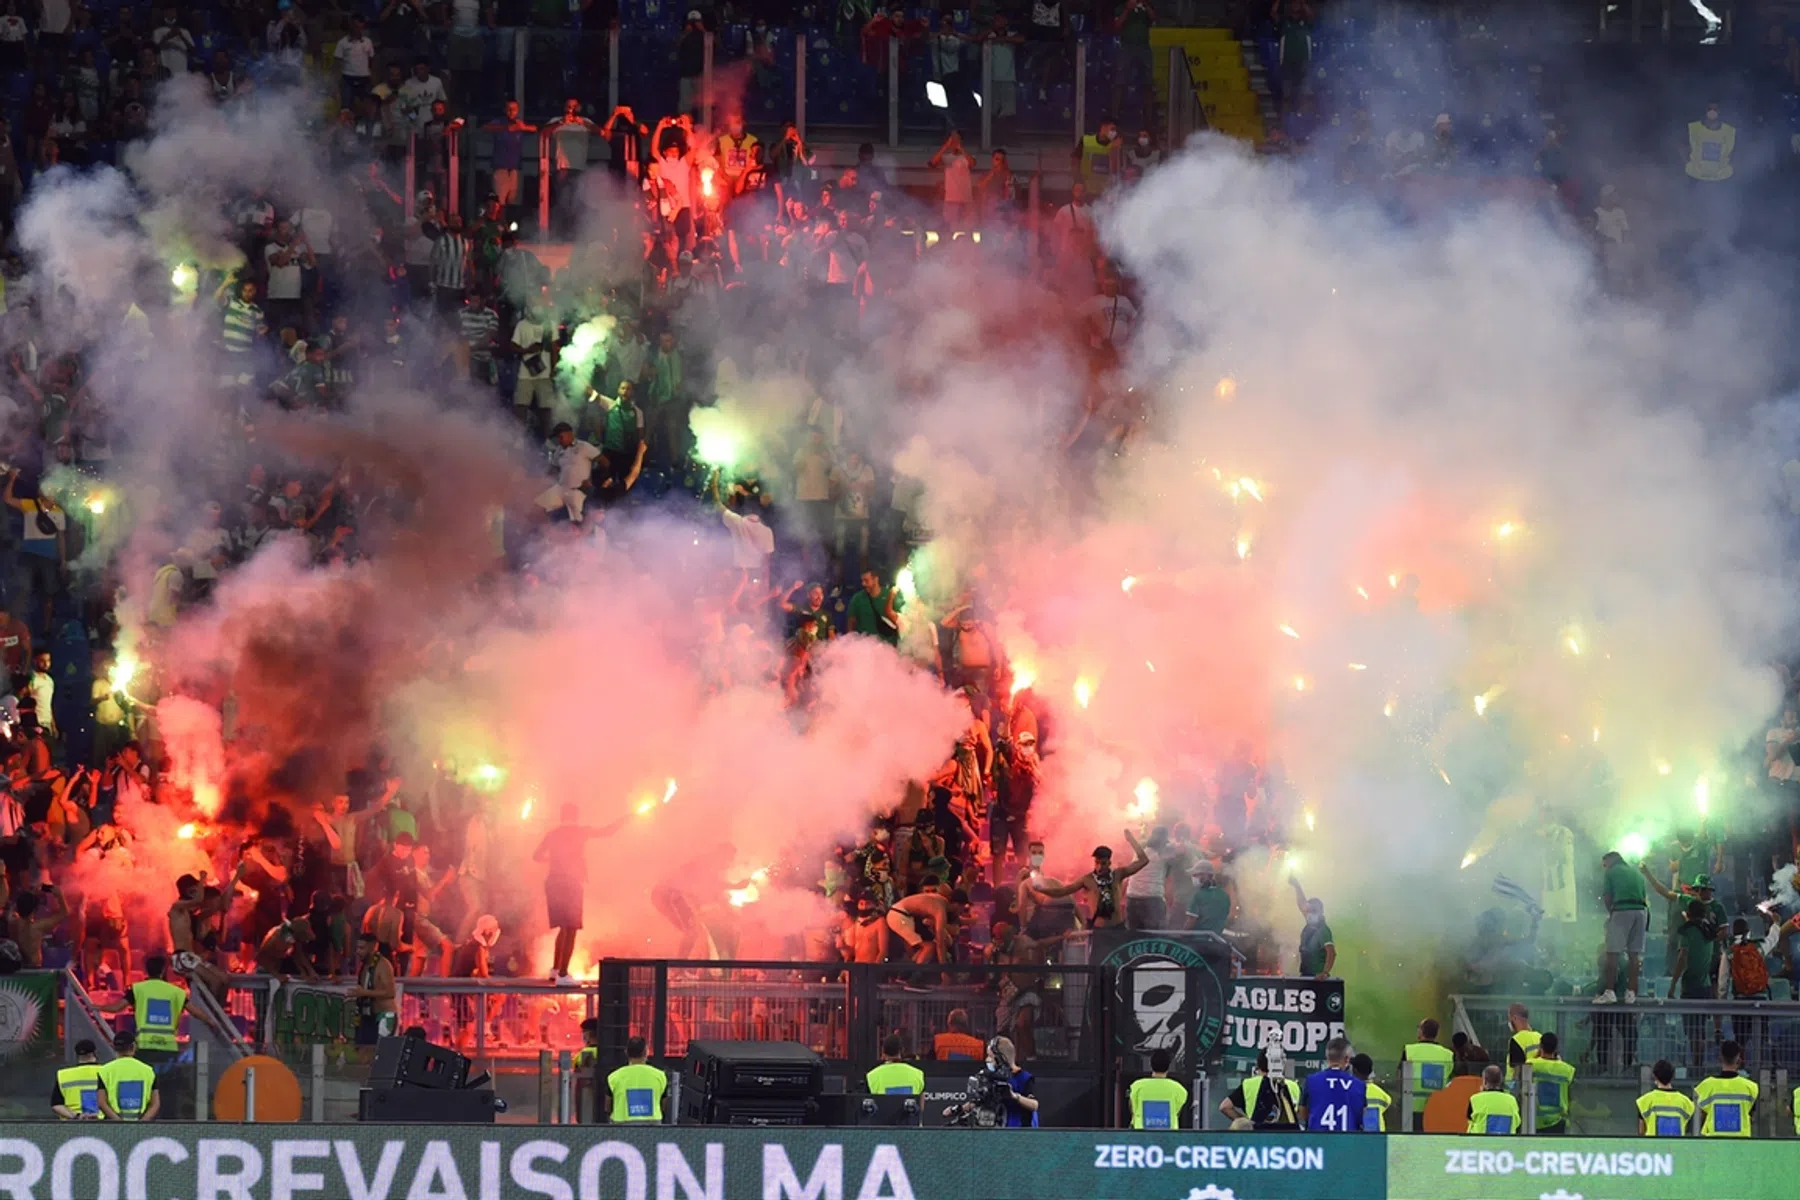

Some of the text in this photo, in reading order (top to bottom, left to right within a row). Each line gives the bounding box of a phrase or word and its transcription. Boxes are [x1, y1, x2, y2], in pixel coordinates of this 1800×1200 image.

[1227, 985, 1316, 1013] AGLES
[924, 1092, 967, 1101] OLIMPICO
[1326, 1077, 1352, 1090] TV
[1320, 1103, 1348, 1132] 41
[1094, 1144, 1324, 1170] ZERO-CREVAISON
[1444, 1149, 1673, 1176] ZERO-CREVAISON
